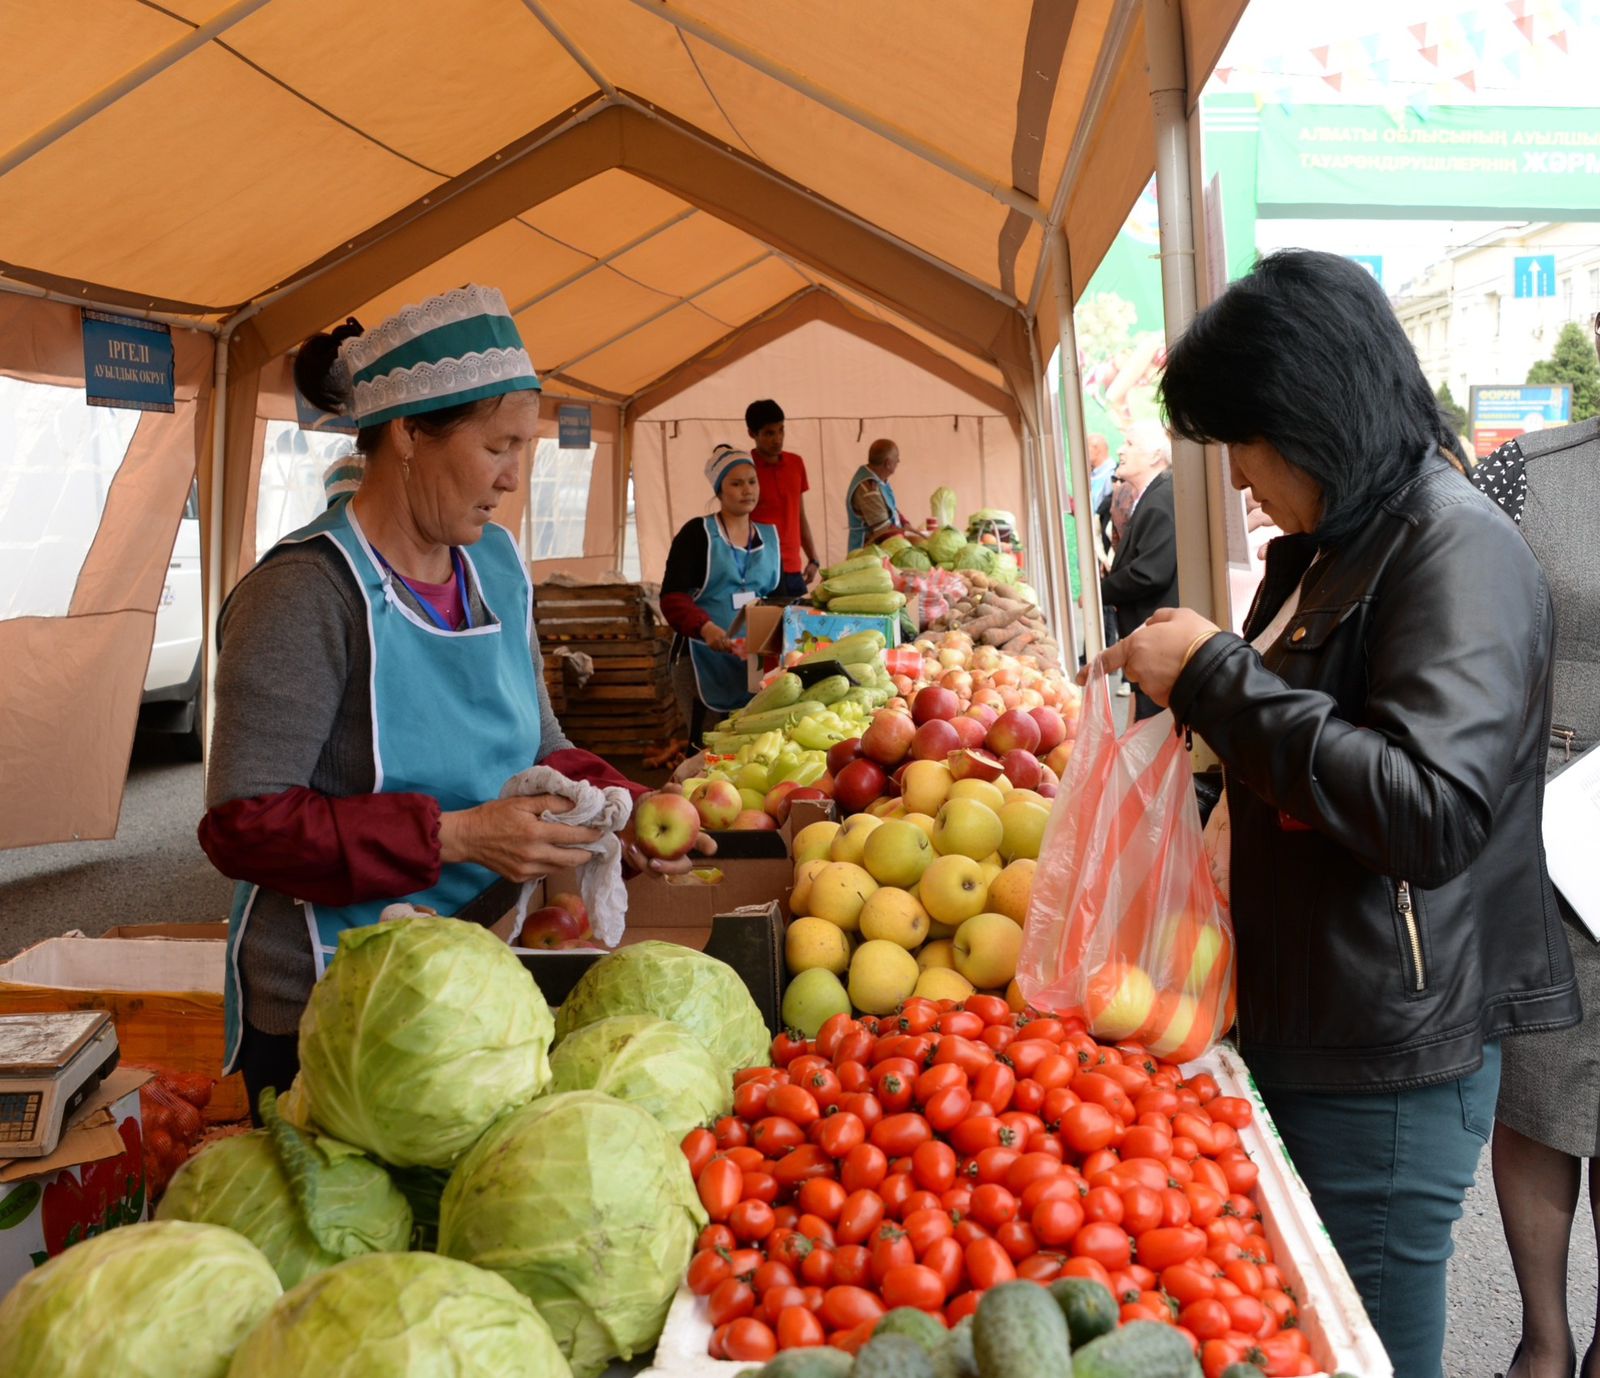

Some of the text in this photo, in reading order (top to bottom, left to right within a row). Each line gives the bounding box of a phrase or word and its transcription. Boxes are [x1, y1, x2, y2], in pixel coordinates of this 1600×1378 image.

[1298, 127, 1378, 144] АЛМАТЫ
[109, 339, 149, 363] ІРГЕЛІ
[139, 369, 166, 385] ОКРУГ
